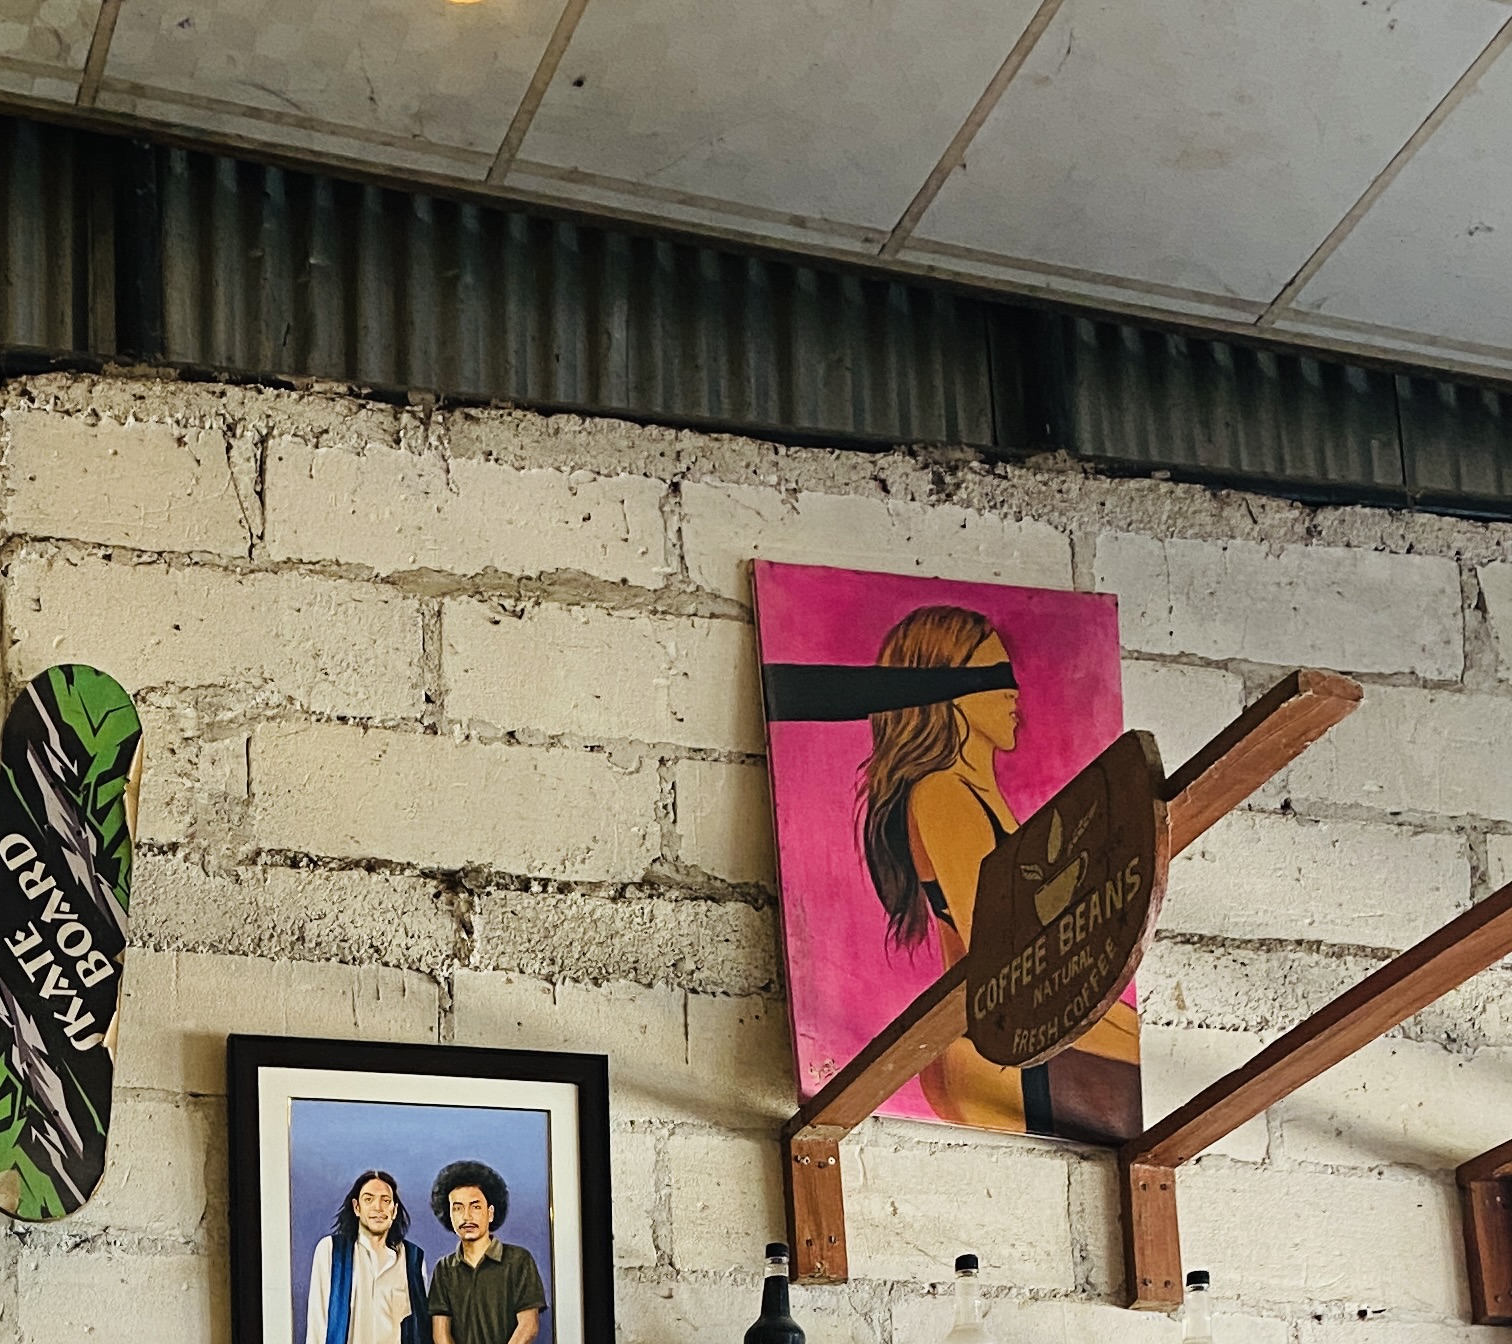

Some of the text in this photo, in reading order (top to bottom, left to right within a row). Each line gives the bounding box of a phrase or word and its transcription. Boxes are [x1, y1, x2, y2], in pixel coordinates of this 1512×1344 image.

[4, 920, 105, 1051] SKATE
[973, 856, 1141, 1020] COFFEE BEANS
[1013, 936, 1116, 1055] FRESH COFFEE
[1033, 946, 1094, 1009] NATURAL
